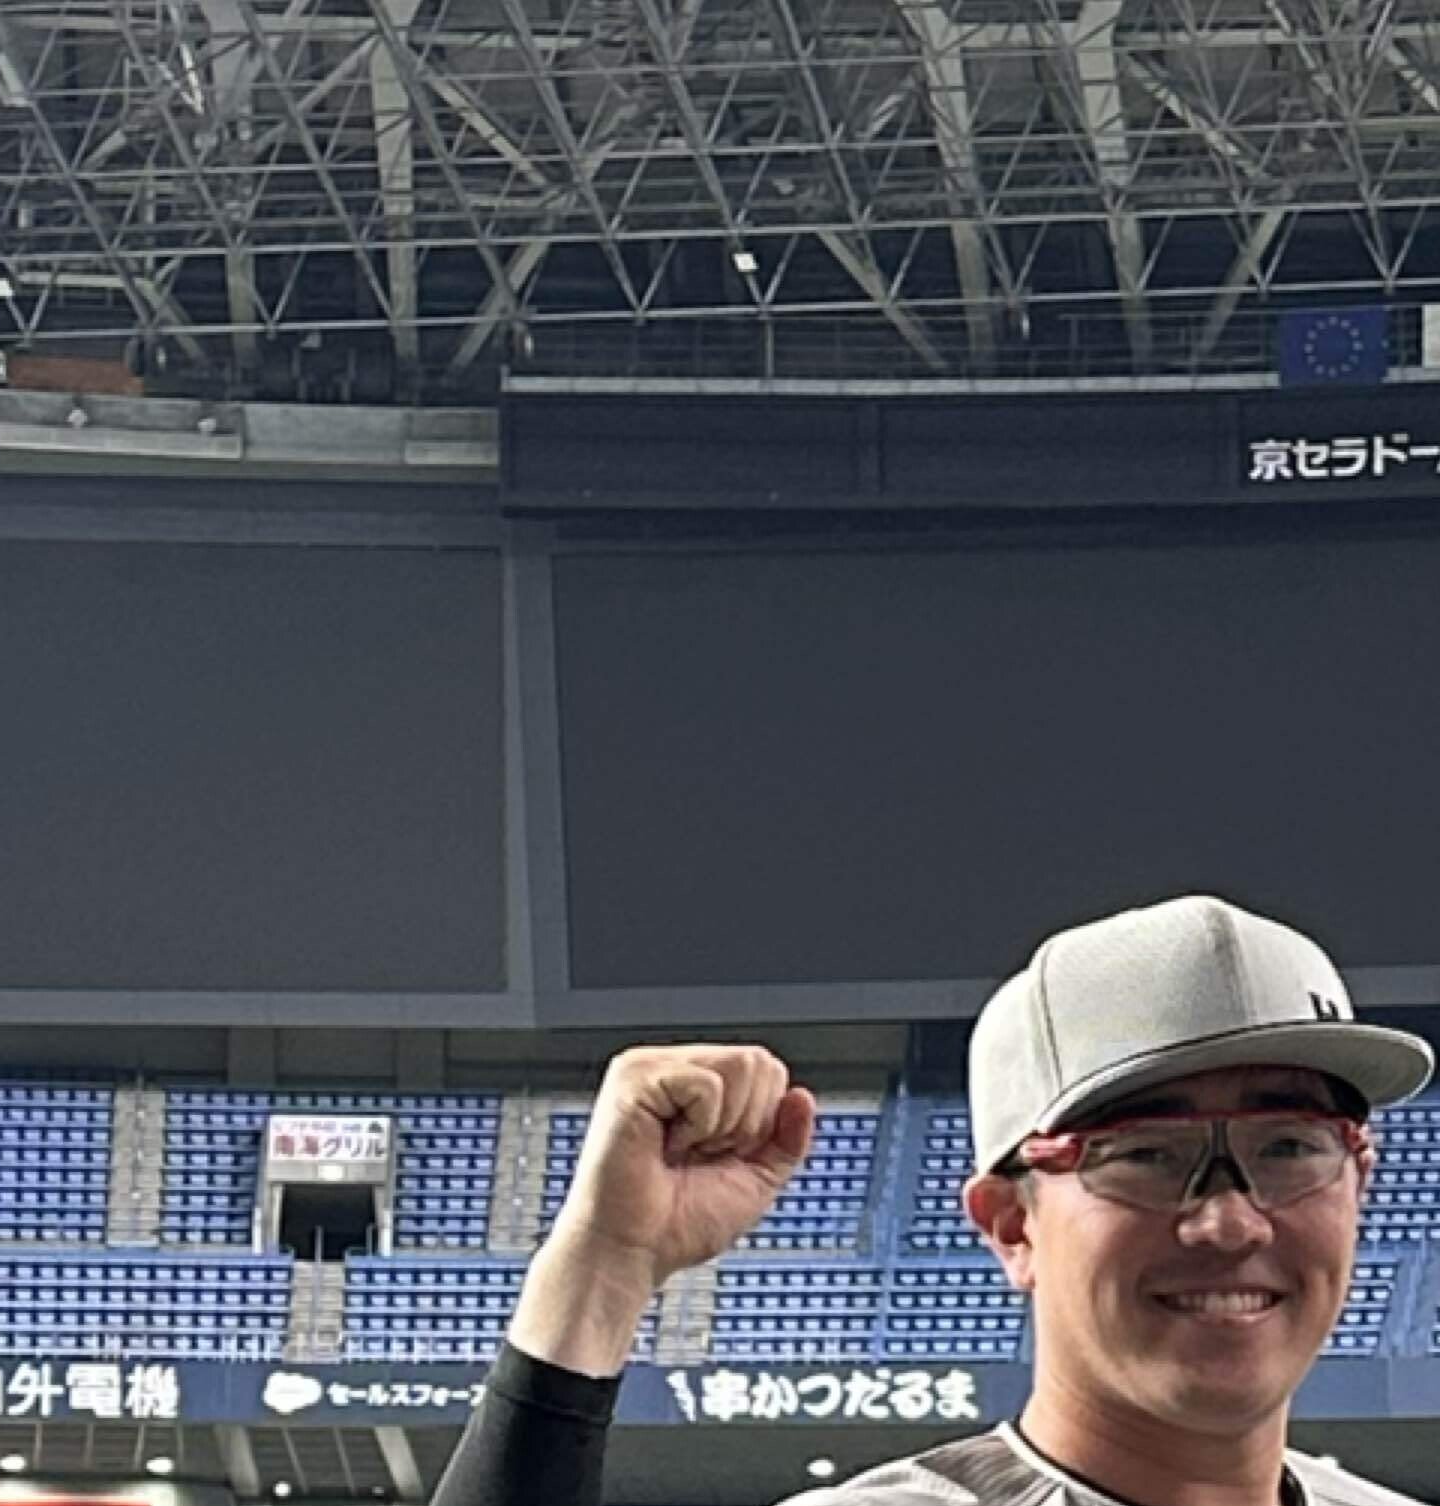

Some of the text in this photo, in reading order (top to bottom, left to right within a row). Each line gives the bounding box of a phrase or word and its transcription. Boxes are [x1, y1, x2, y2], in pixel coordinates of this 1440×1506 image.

[702, 1370, 980, 1421] 串かつだるま
